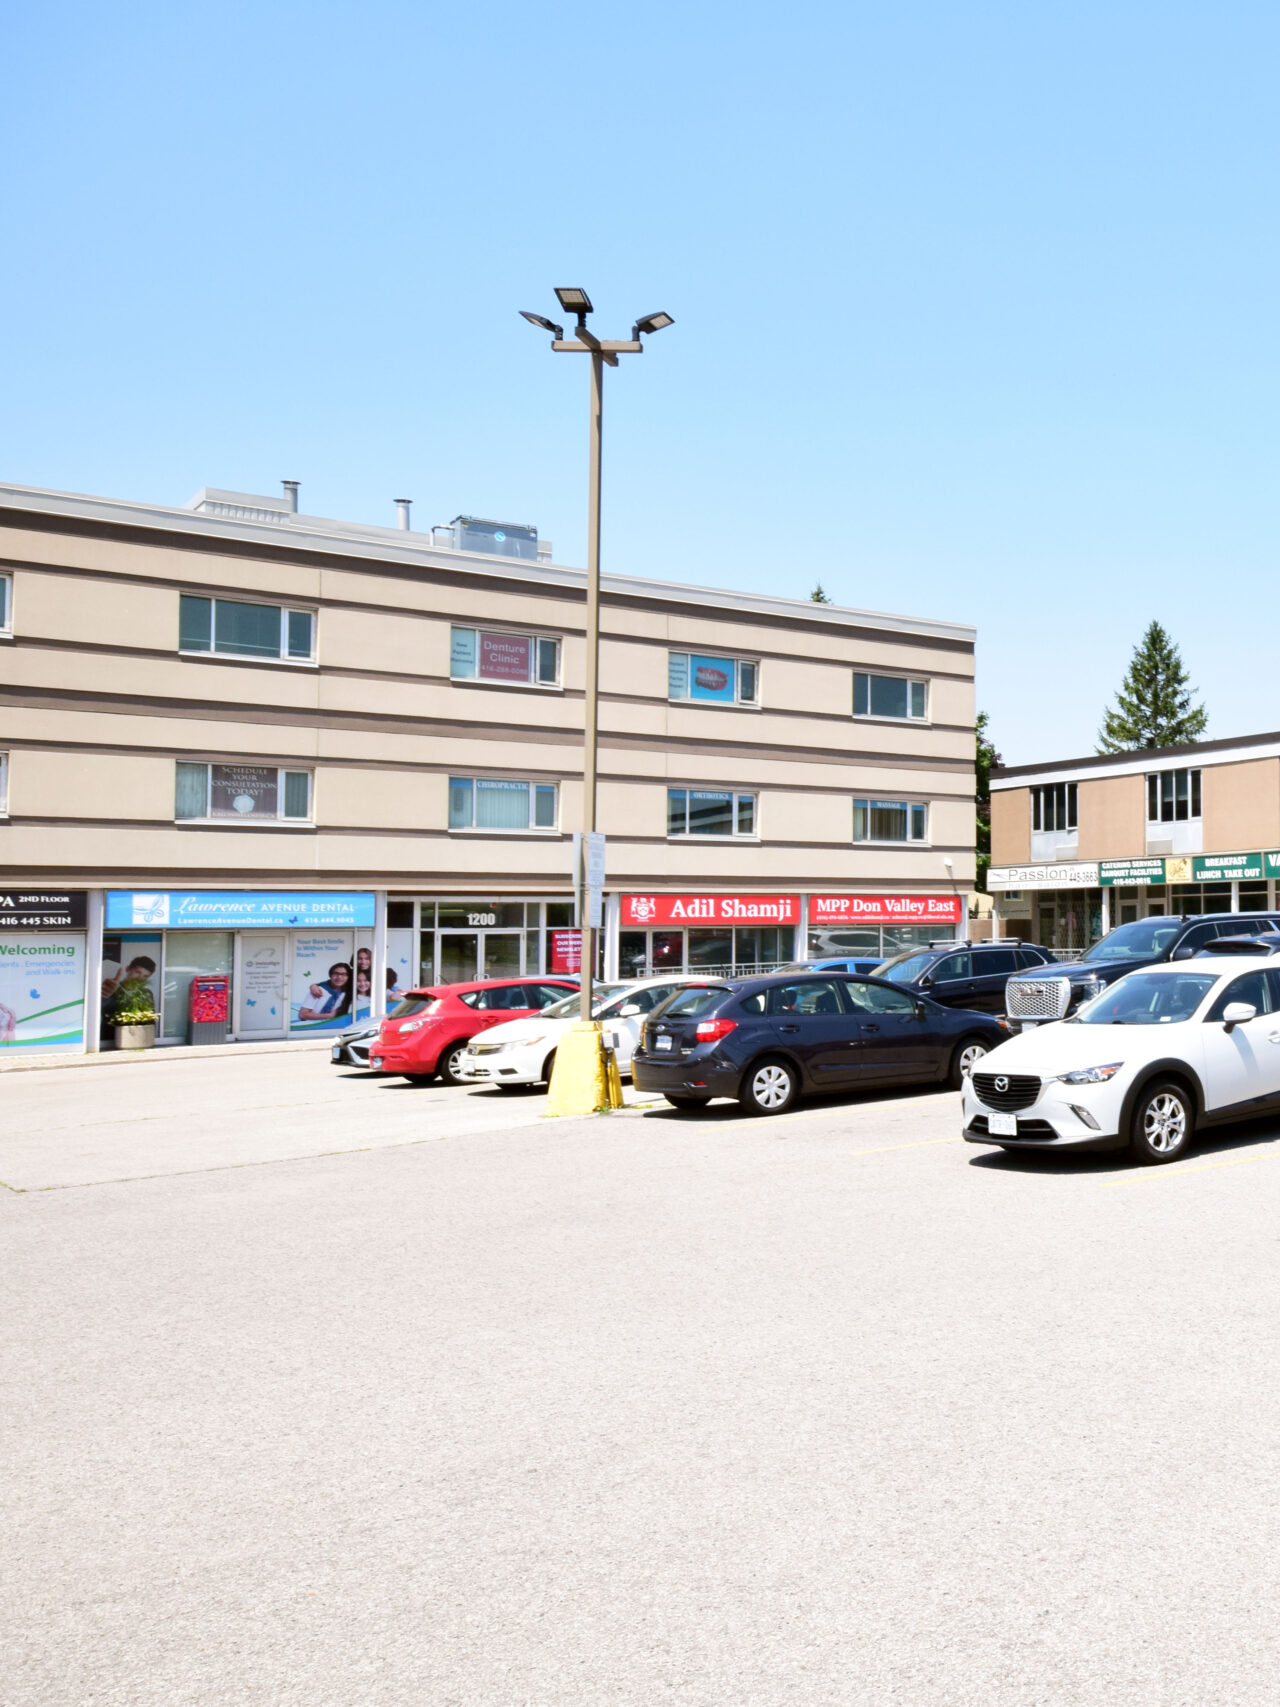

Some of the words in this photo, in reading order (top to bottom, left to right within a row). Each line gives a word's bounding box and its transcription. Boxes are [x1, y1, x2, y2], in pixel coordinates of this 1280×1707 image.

[484, 640, 526, 654] Denture
[489, 652, 520, 664] Clinic
[222, 766, 268, 775] SCHEDULE
[211, 780, 277, 789] CONSULTATION
[477, 781, 529, 790] CHIROPRACTIC
[1131, 859, 1162, 868] SERVICES
[1204, 856, 1248, 867] BREAKFAST
[1008, 866, 1067, 880] Passion
[1101, 869, 1129, 877] BANQUET
[1129, 867, 1163, 876] FACILITIES
[1196, 870, 1221, 880] LUNCH
[1224, 869, 1243, 879] TAKE
[1243, 868, 1261, 878] OUT
[173, 896, 256, 915] Lawrence
[260, 903, 307, 912] AVENUE
[312, 903, 355, 912] DENTAL
[669, 899, 715, 918] Adil
[721, 899, 792, 921] Shamji
[816, 899, 850, 912] MPP
[853, 899, 881, 912] Don
[884, 899, 925, 914] Valley
[927, 899, 955, 912] East
[20, 917, 41, 925] 445
[42, 916, 71, 925] SKIN
[467, 913, 496, 926] 1200
[0, 944, 75, 957] Welcoming
